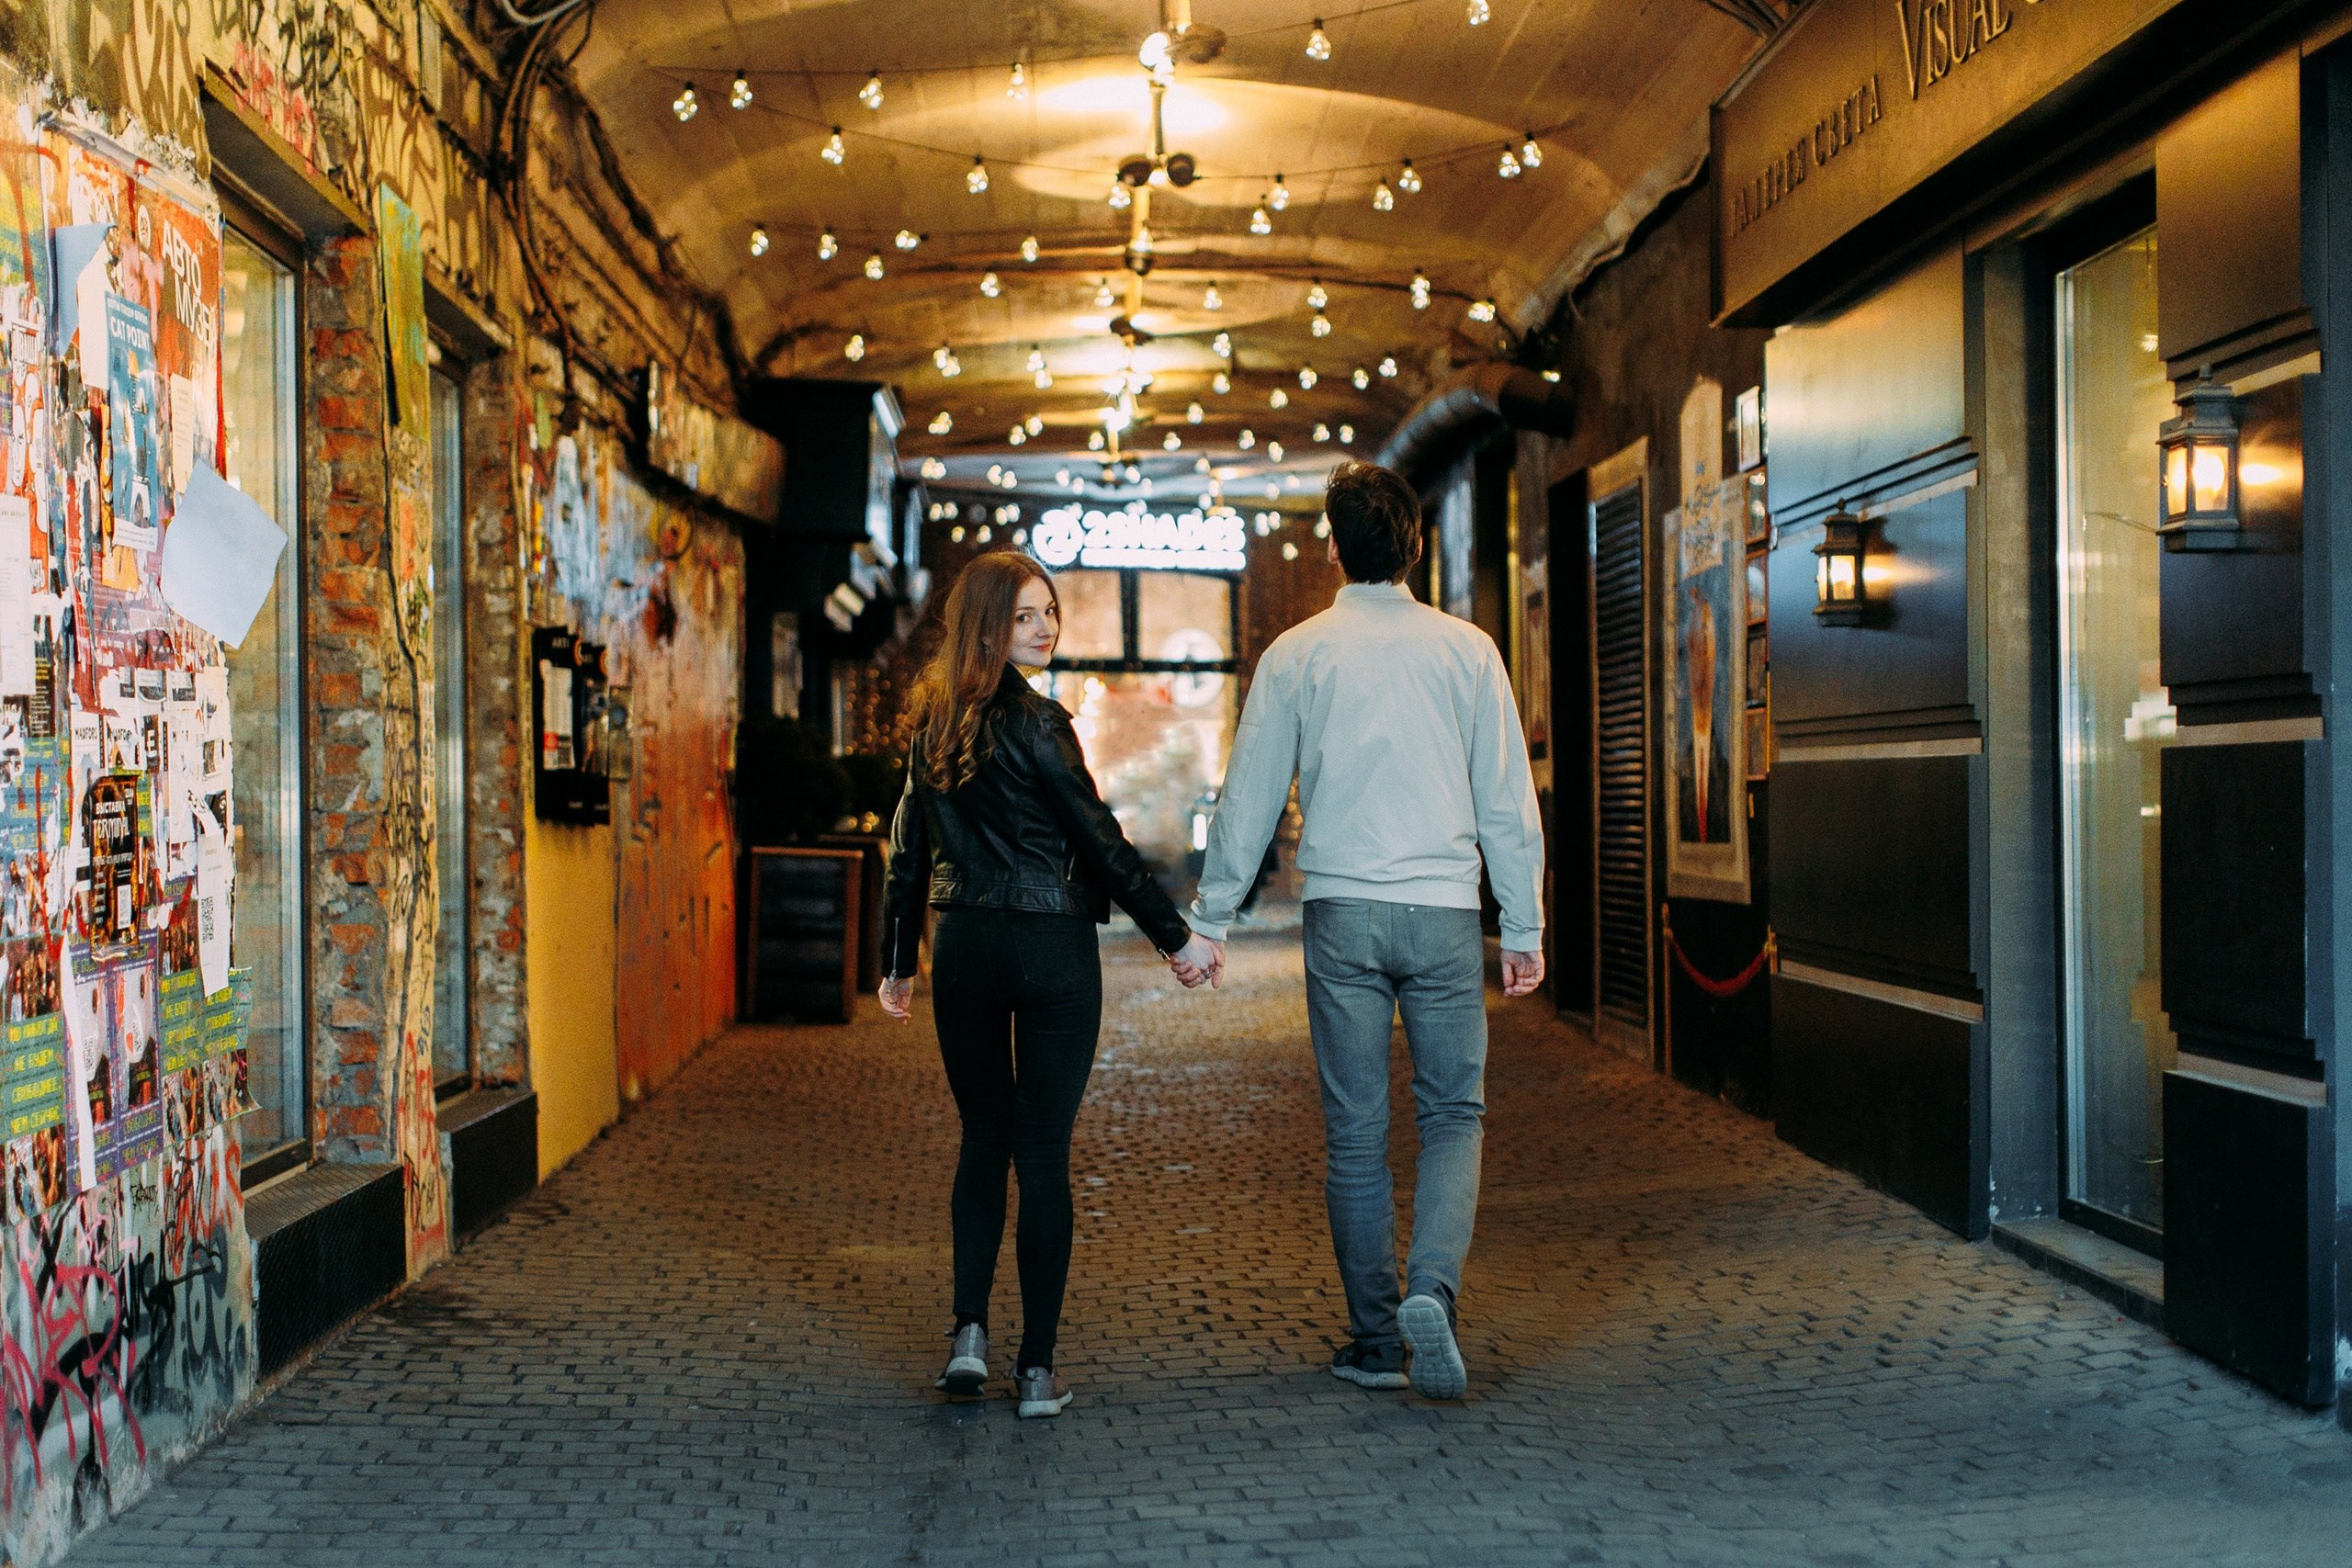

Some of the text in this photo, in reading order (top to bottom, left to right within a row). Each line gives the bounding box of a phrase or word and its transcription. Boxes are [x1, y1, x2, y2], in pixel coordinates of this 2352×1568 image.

[1813, 73, 1882, 166] СВЕТА
[163, 220, 202, 297] АВТО
[109, 316, 151, 354] CAT POINT
[175, 272, 218, 349] МУЗЕЙ
[96, 800, 126, 816] ВЫСТАВКА
